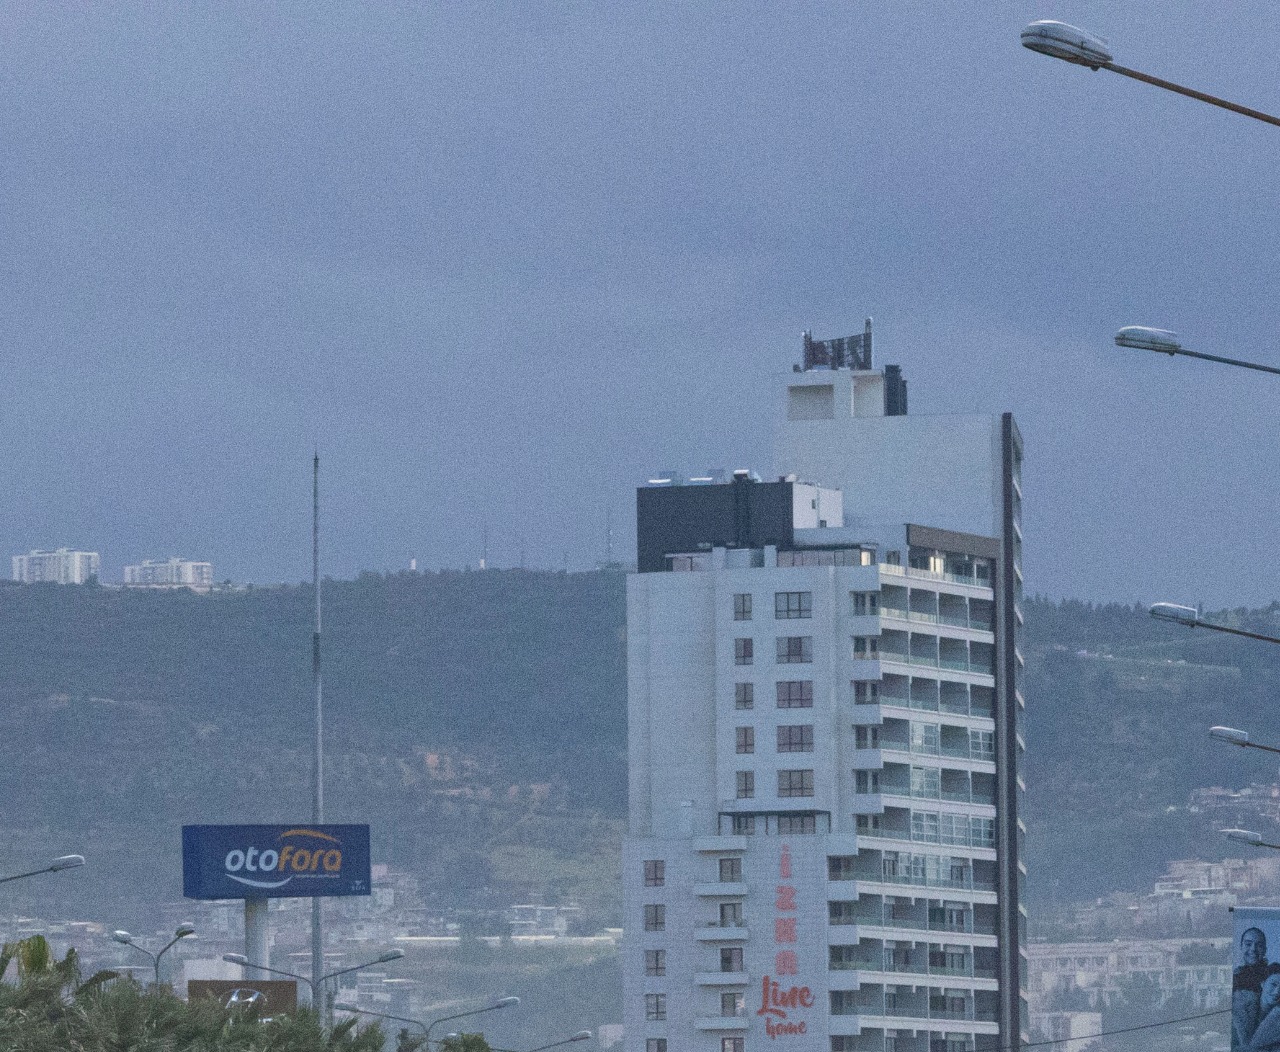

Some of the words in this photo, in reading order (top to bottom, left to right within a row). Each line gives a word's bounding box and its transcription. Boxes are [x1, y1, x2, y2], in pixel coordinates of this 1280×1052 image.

[224, 846, 342, 872] otofora
[757, 975, 816, 1019] Line
[766, 1017, 807, 1040] home
